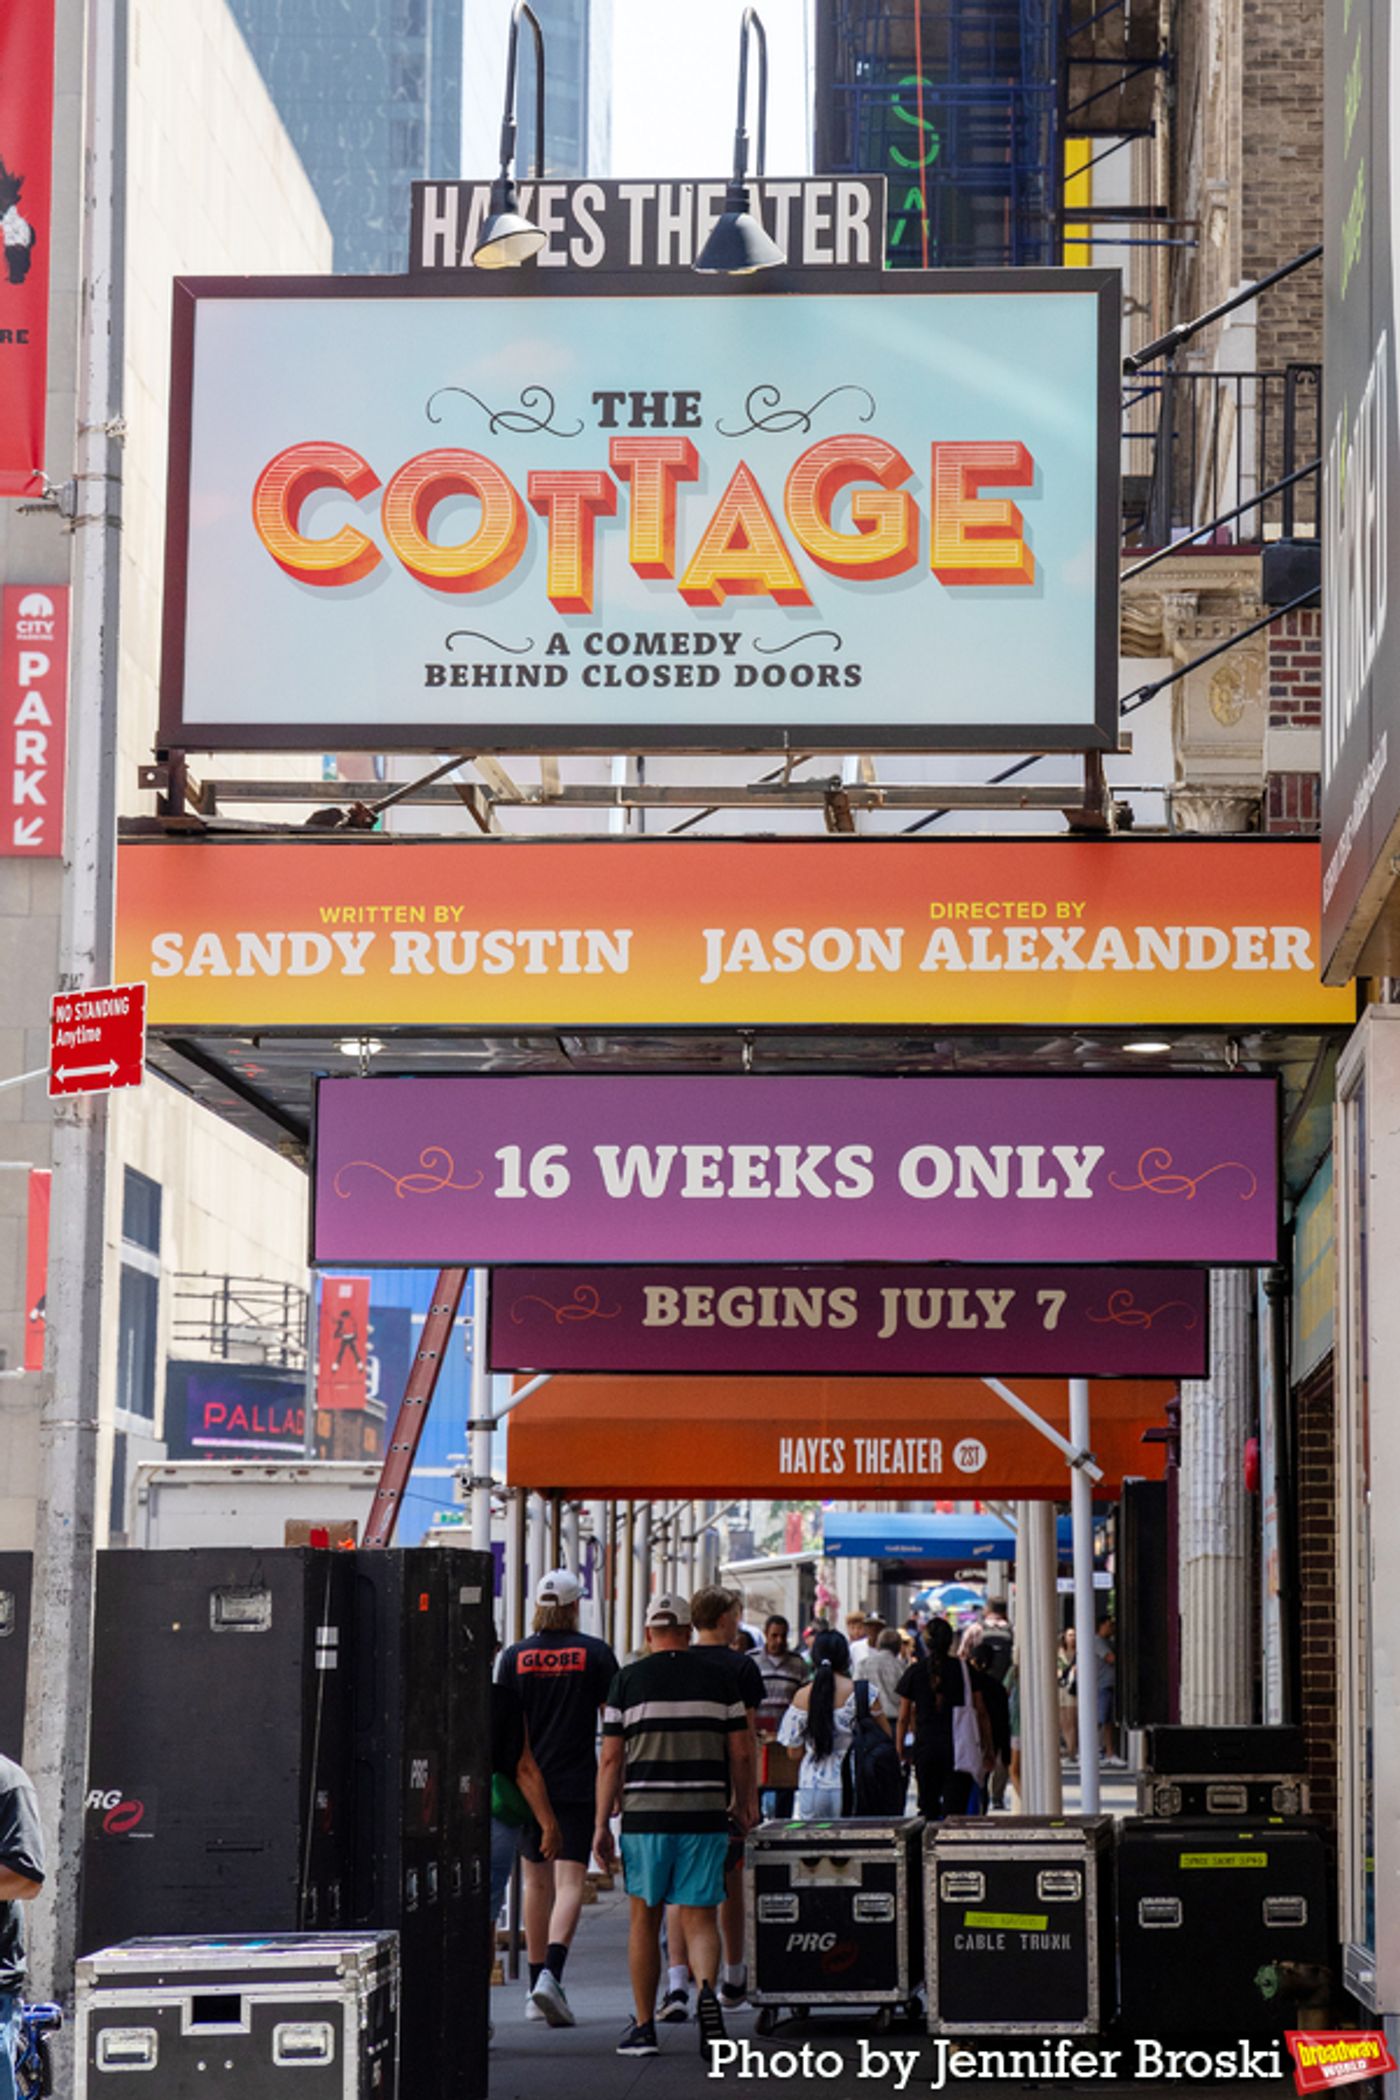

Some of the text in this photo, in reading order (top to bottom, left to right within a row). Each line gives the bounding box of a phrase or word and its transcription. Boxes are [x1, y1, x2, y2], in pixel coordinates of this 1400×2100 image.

[592, 391, 702, 428] THE
[252, 433, 1035, 614] COTTAGE
[16, 620, 55, 634] CITY
[545, 632, 743, 656] A COMEDY
[424, 664, 863, 688] BEHIND CLOSED DOORS
[13, 651, 52, 806] PARK
[318, 905, 466, 925] WRITTEN BY
[929, 901, 1087, 920] DIRECTED BY
[150, 928, 634, 977] SANDY RUSTIN
[699, 926, 1316, 985] JASON ALEXANDER
[55, 996, 130, 1023] NO STANDING
[55, 1024, 102, 1049] Anytime
[494, 1144, 1106, 1199] 16 WEEKS ONLY
[641, 1285, 1067, 1339] BEGINS JULY 7
[203, 1401, 305, 1437] PALLAD
[779, 1437, 846, 1474] HAYES
[853, 1437, 943, 1474] THEATER
[522, 1651, 580, 1668] GLOBE
[785, 1931, 838, 1953] PRG
[953, 1933, 1006, 1951] CABLE
